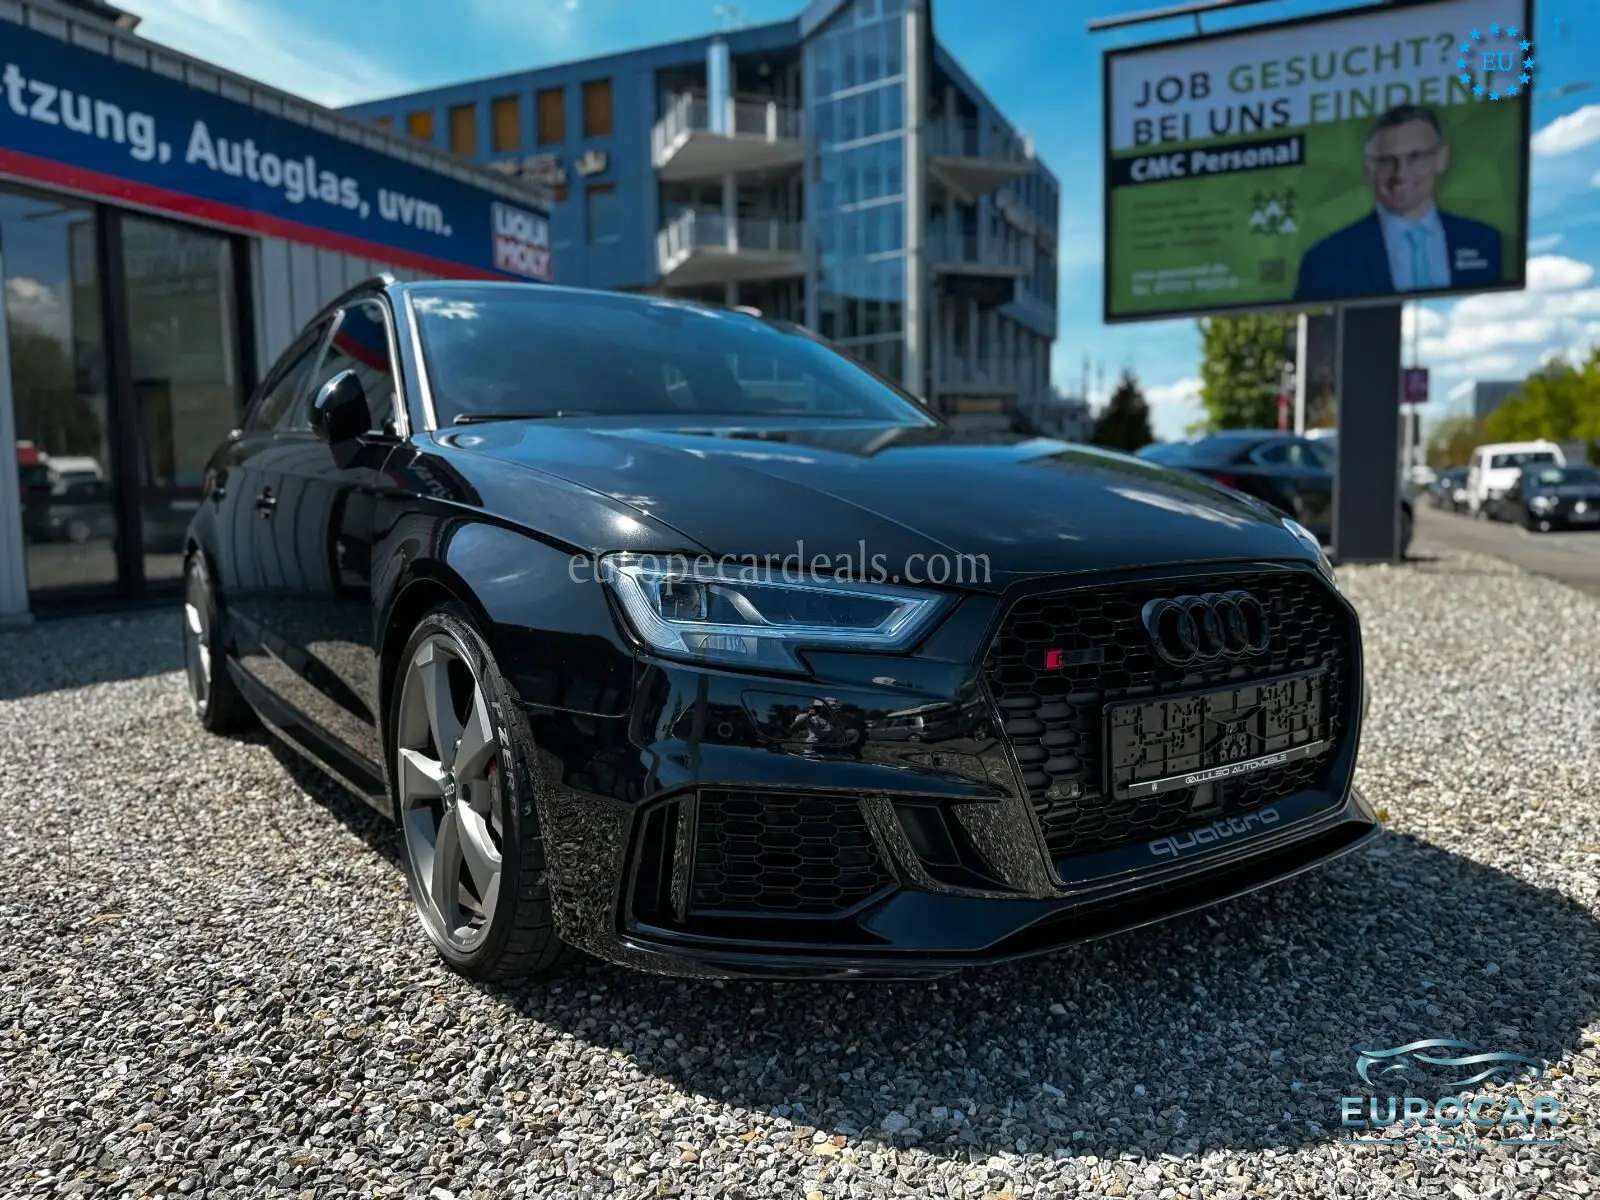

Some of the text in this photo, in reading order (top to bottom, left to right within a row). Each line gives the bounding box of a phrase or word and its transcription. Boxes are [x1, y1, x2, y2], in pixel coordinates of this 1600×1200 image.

[1134, 34, 1454, 108] JOB GESUCHT?
[1133, 112, 1190, 147] BEI
[1210, 99, 1291, 137] UNS
[0, 64, 453, 236] tzung, Autoglas, uvm.
[1130, 137, 1300, 182] CMC Personal
[495, 208, 549, 249] LIQUI
[497, 238, 552, 280] MOLY
[1149, 806, 1280, 856] quattro
